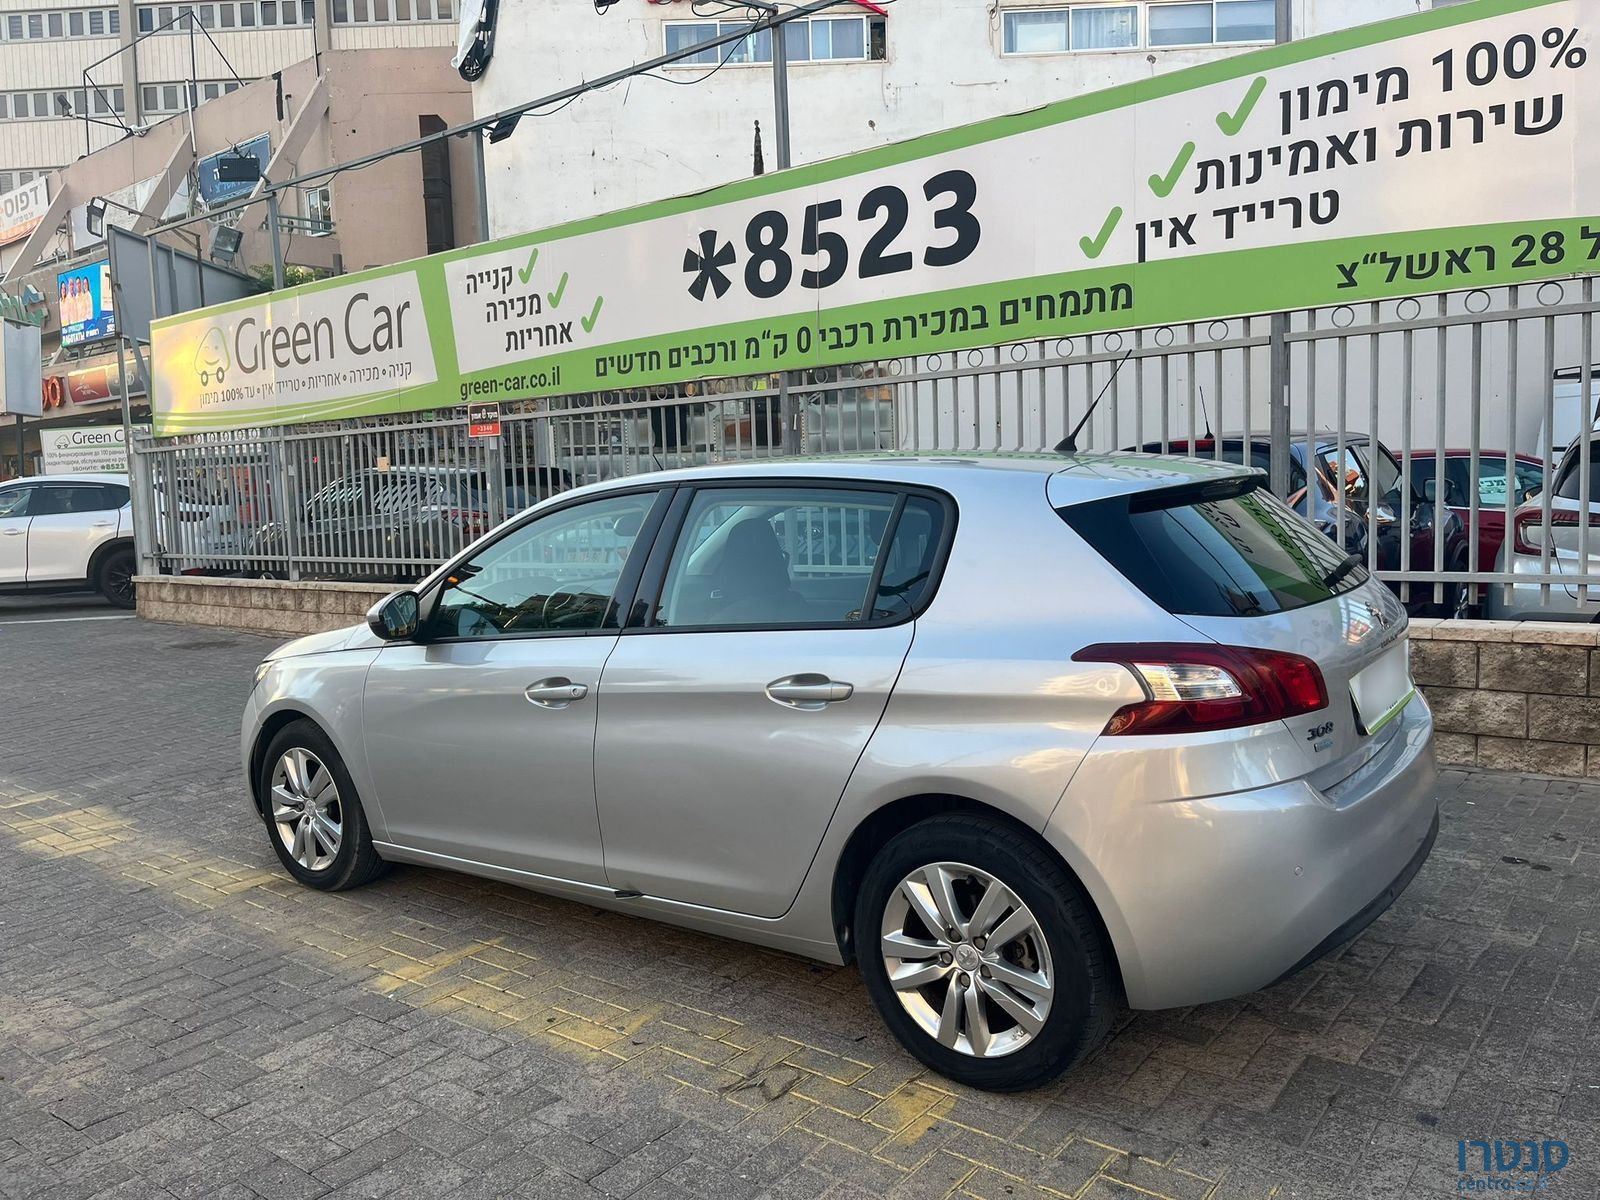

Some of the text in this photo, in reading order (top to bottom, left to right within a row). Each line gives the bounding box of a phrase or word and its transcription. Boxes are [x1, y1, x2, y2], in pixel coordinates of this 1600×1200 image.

[1279, 27, 1587, 136] 100% מימון
[1194, 93, 1564, 195] שירות ואמינות
[4, 185, 39, 218] דפוס
[1135, 188, 1340, 263] טרייד אין
[1511, 231, 1565, 269] 28
[466, 266, 514, 295] קנייה
[486, 293, 542, 323] מכירה
[999, 281, 1134, 326] מתמחים
[234, 293, 411, 375] Green Car
[505, 320, 574, 352] אחריות
[819, 321, 875, 351] רכבי
[882, 305, 989, 344] במכירת
[595, 349, 662, 378] חדשים
[668, 338, 737, 368] ורכבים
[200, 361, 412, 408] קניה מכירה אחריות טרייד אין עד 100% מימון
[459, 366, 561, 401] green-car.co.il
[72, 431, 111, 444] Green
[1307, 721, 1334, 741] 308
